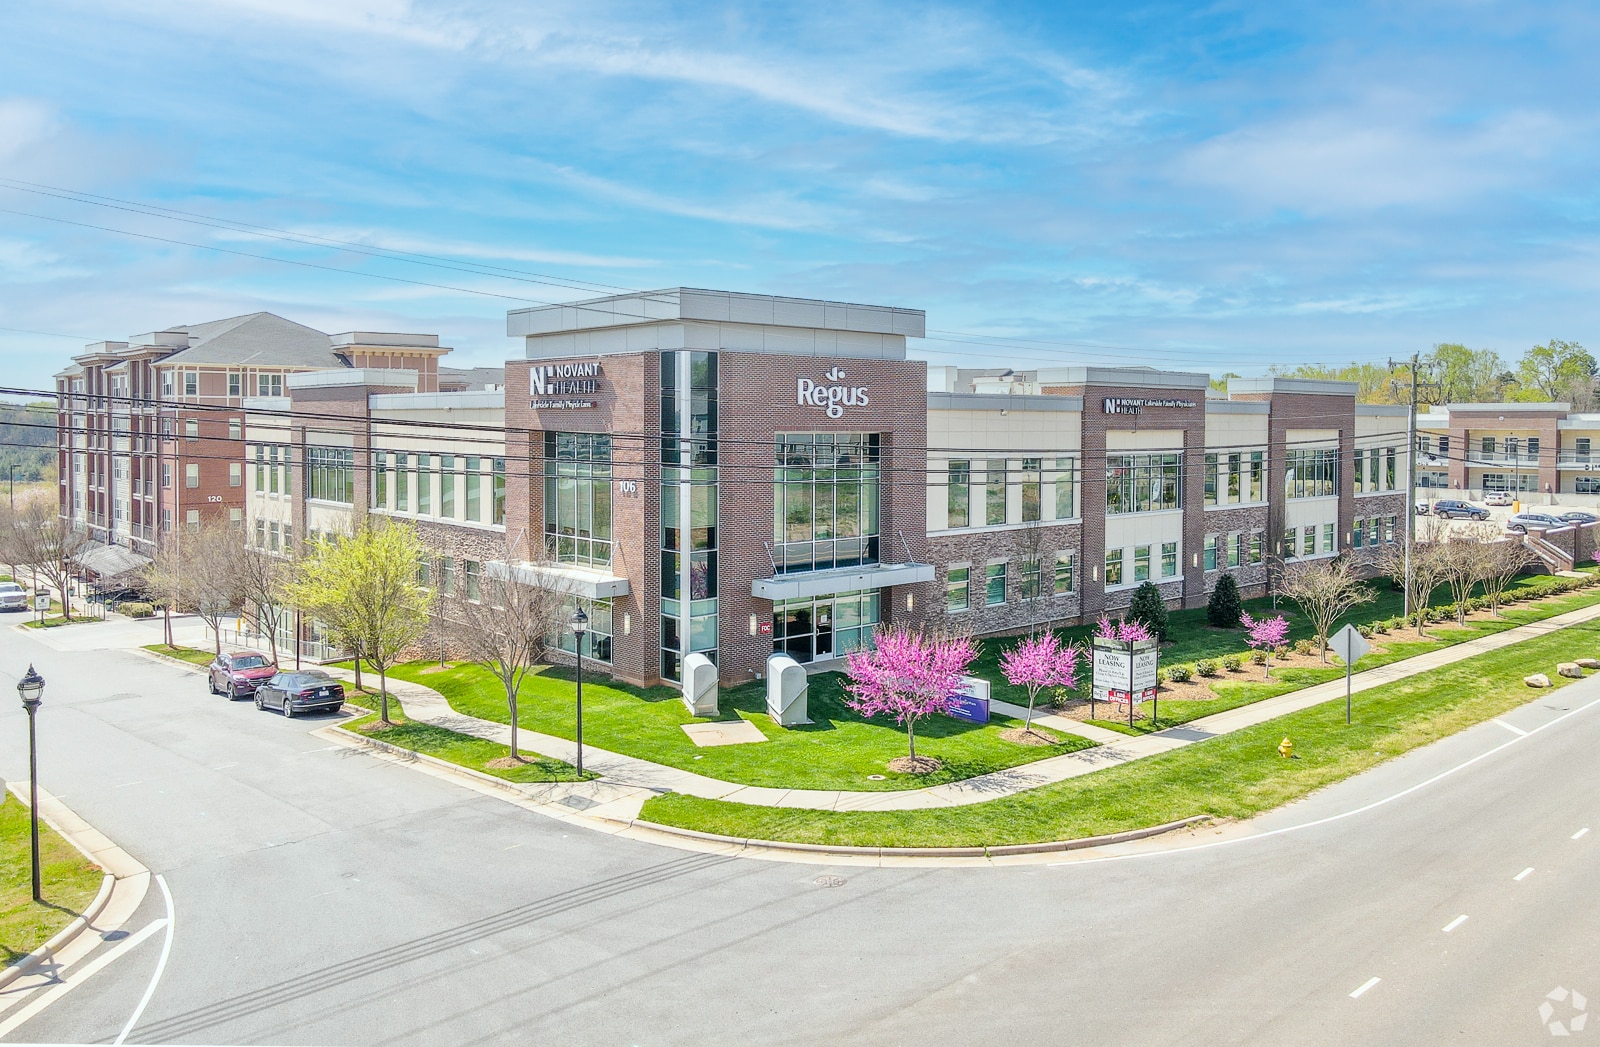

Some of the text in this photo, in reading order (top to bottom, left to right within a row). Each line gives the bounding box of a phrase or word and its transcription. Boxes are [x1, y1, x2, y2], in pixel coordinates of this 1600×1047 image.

[556, 363, 599, 378] NOVANT
[556, 380, 596, 394] HEALTH
[797, 378, 869, 418] Regus
[1121, 399, 1144, 407] NOVANT
[1121, 406, 1143, 415] HEALTH
[619, 480, 636, 493] 106
[207, 495, 223, 503] 120
[1098, 659, 1125, 668] LEASING
